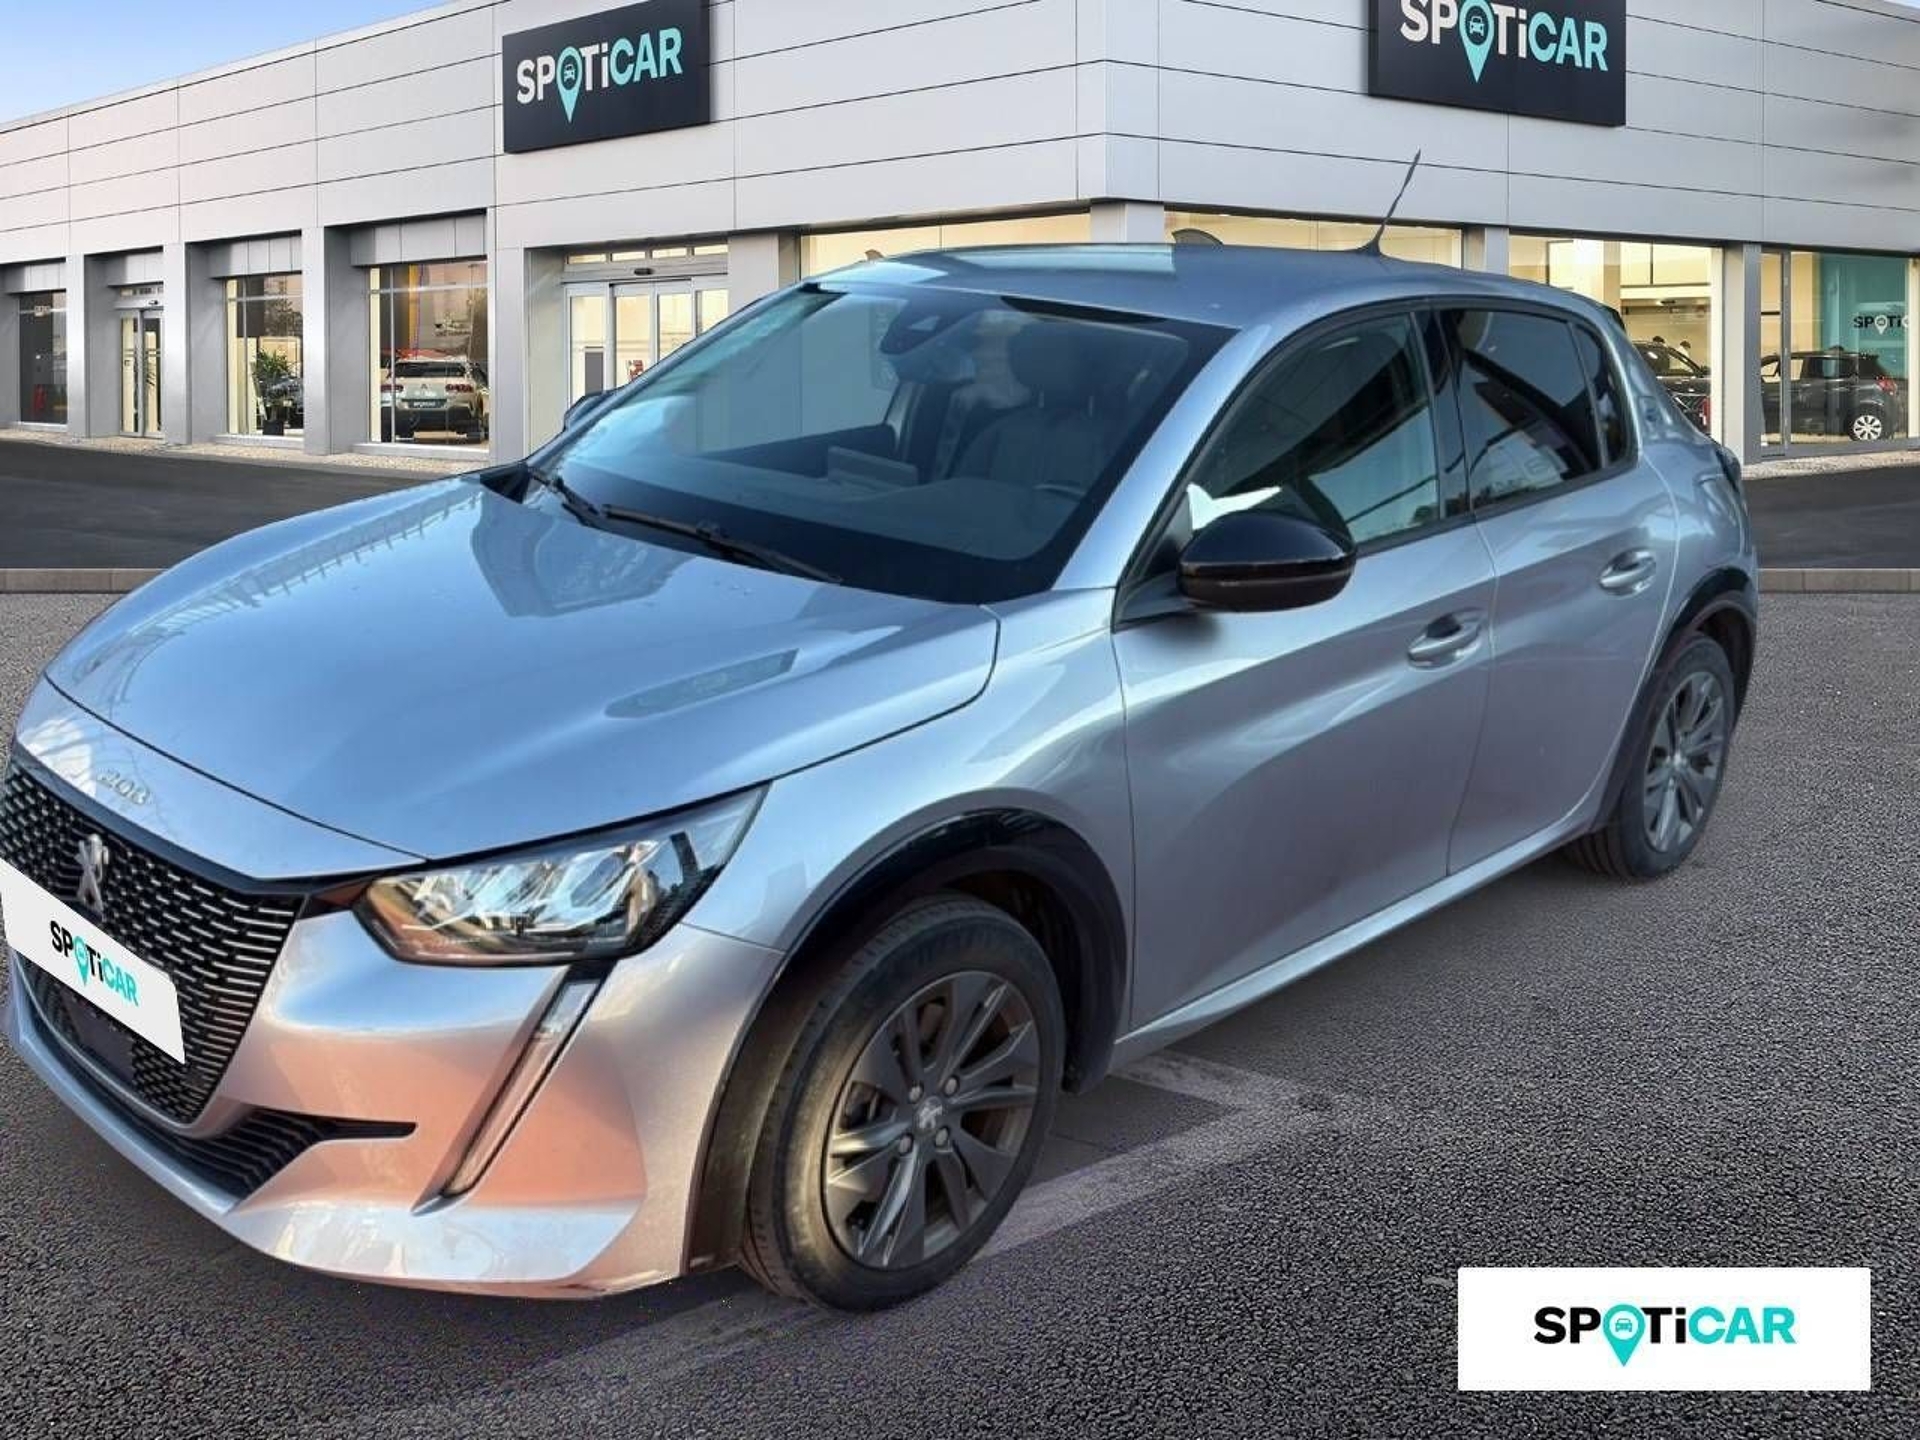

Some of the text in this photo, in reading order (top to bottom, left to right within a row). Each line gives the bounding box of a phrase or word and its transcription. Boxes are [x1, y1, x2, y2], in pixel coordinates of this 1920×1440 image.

[516, 27, 684, 123] SPOTiCAR
[97, 768, 151, 805] 208
[50, 920, 139, 1006] SPOTiCAR
